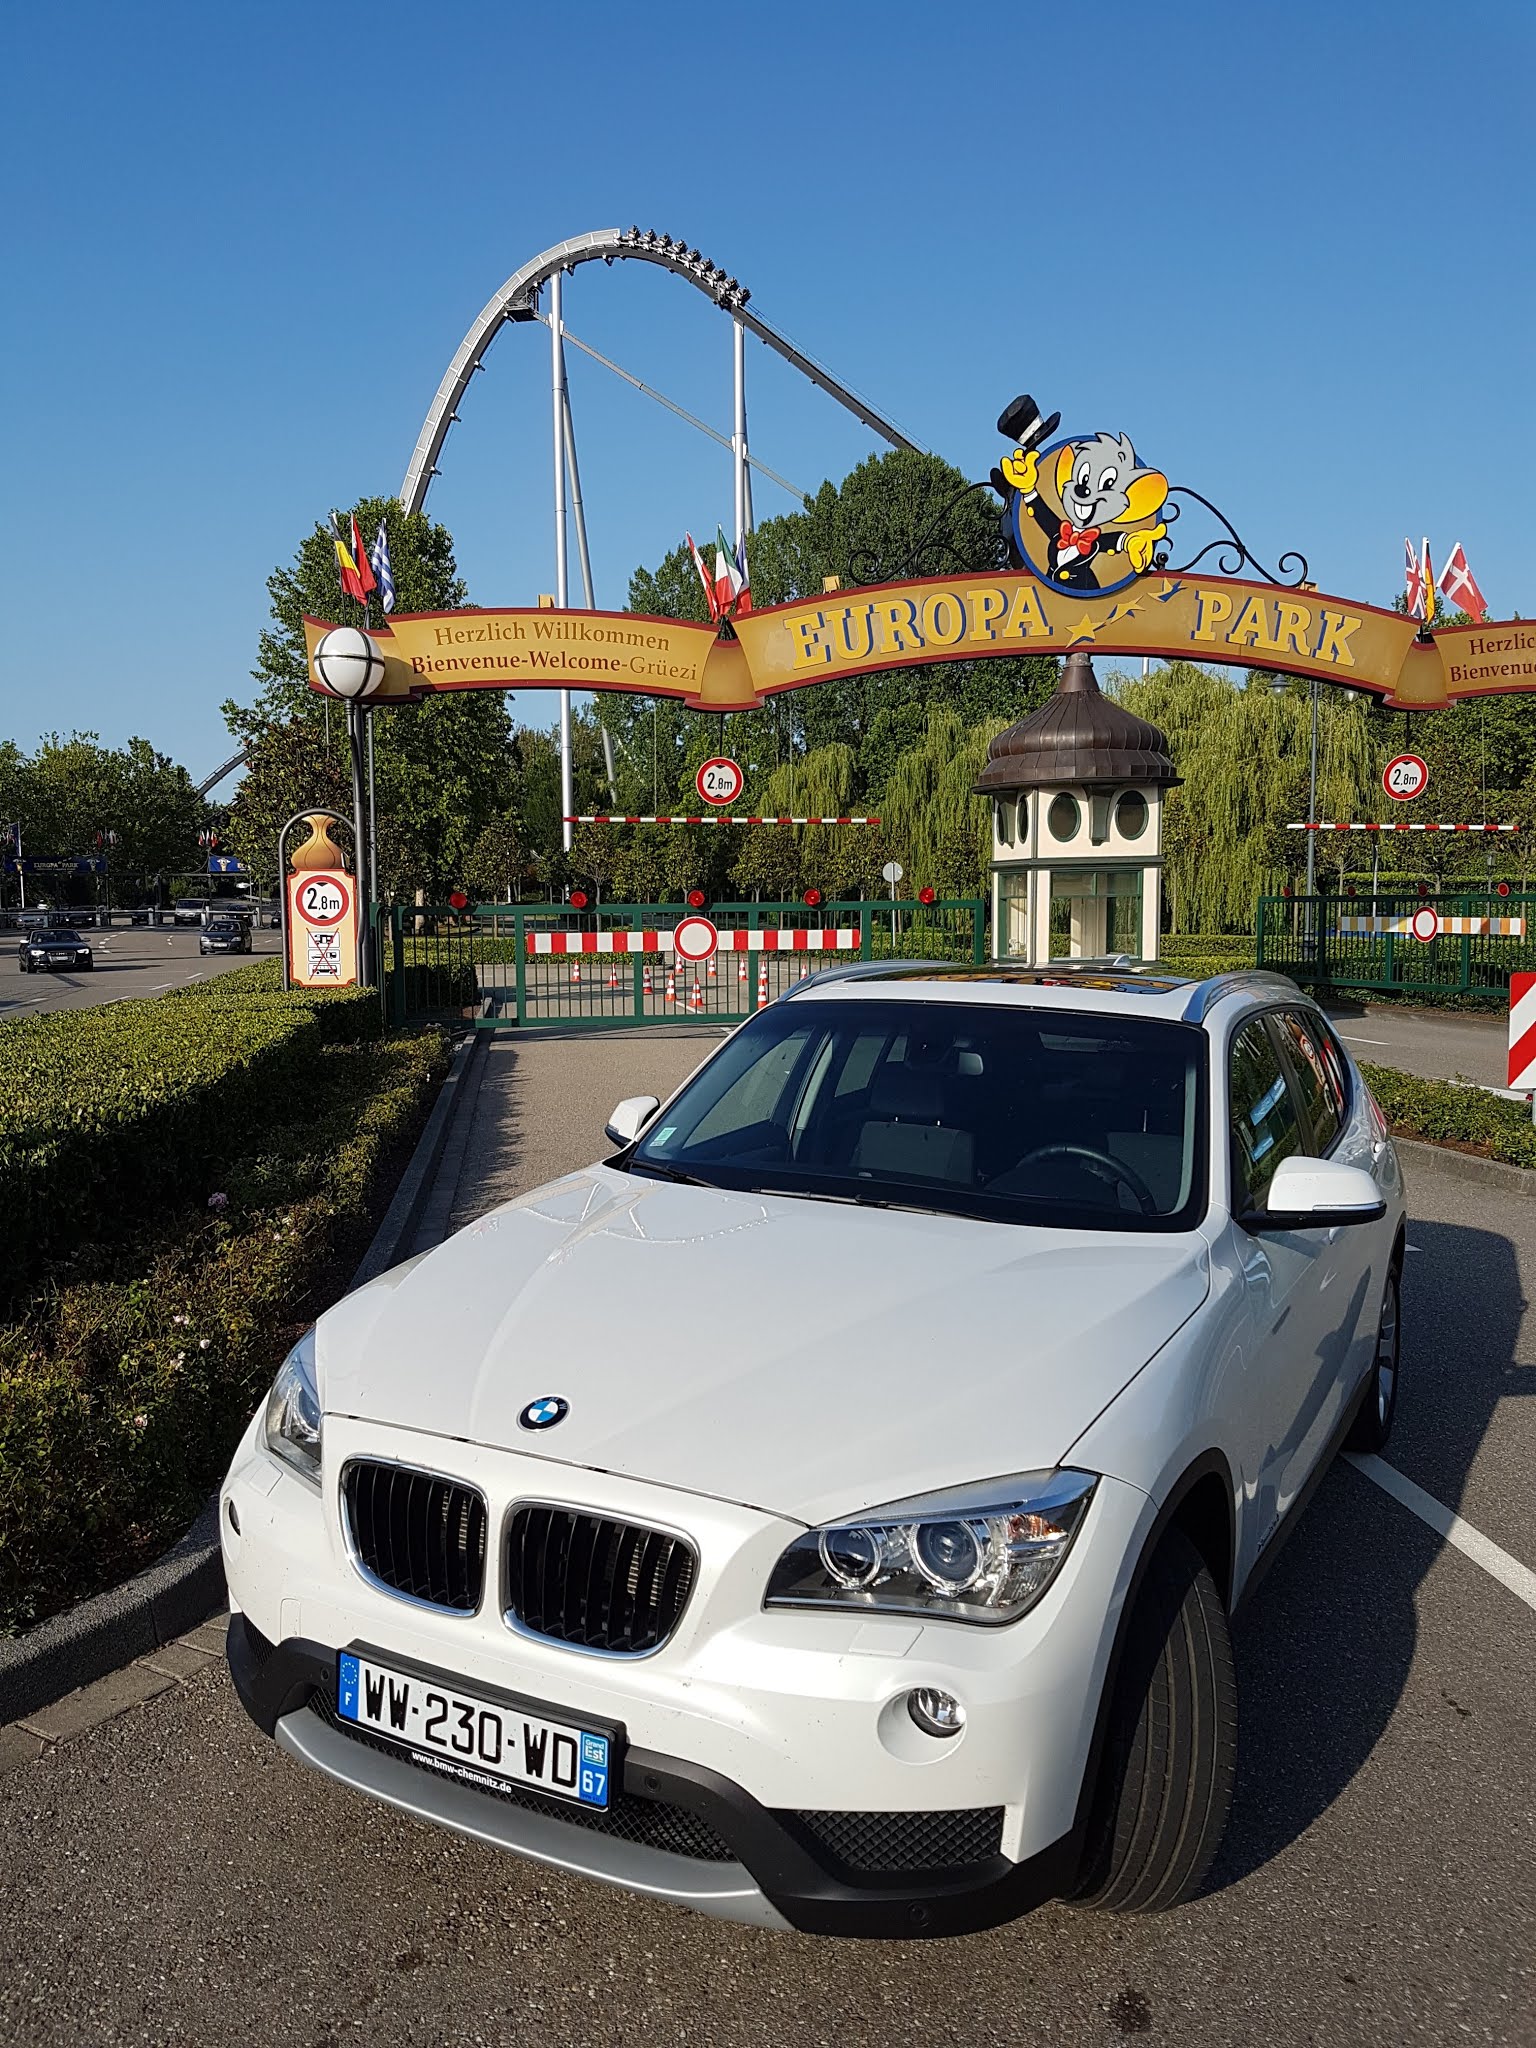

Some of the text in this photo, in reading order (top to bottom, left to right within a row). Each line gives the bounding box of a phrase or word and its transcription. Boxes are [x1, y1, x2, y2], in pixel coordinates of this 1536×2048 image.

[434, 621, 670, 651] Herzlich Willkommen
[783, 585, 1363, 670] EUROPA PARK
[1449, 663, 1536, 682] Bienvenu
[345, 1692, 353, 1706] F
[365, 1669, 578, 1788] WW-230-WD
[584, 1745, 604, 1761] Est
[585, 1739, 605, 1749] Grand
[411, 1751, 512, 1794] www.bmw-chemnitz.de
[582, 1769, 606, 1796] 67
